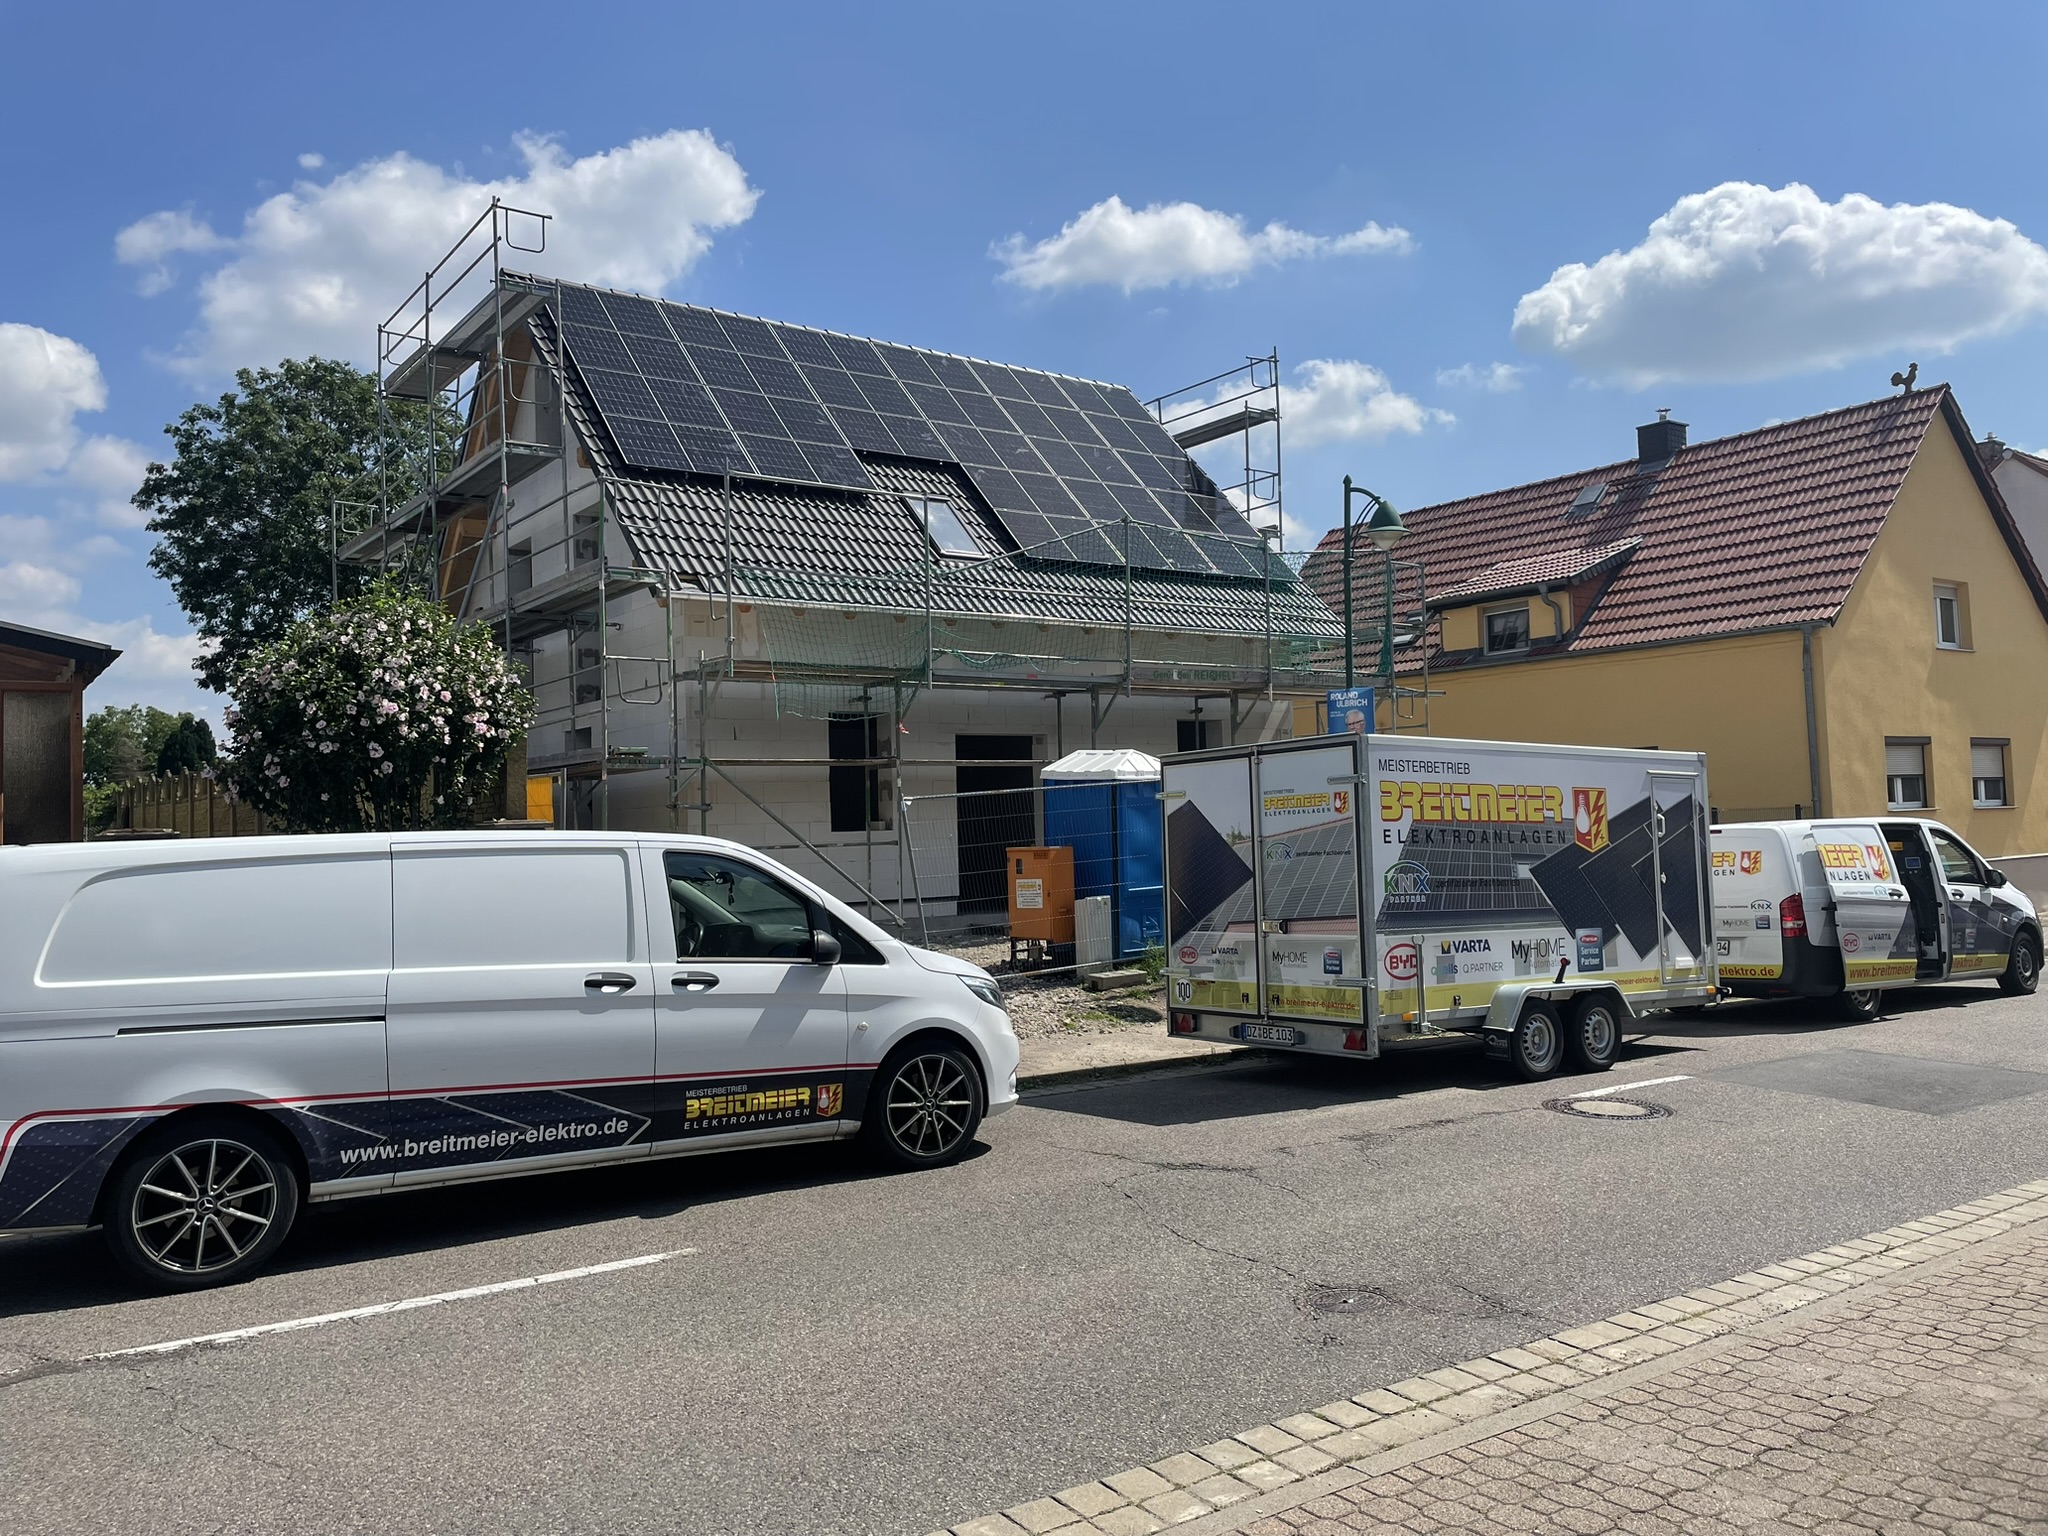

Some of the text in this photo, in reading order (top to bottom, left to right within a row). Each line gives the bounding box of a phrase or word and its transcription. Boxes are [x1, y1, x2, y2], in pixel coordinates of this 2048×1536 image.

[1194, 670, 1237, 680] REICHELT
[1330, 691, 1359, 701] ROLAND
[1336, 698, 1368, 708] ULBRICH
[1378, 758, 1471, 775] MEISTERBETRIEB
[1263, 792, 1331, 811] BREITMEIER
[1380, 780, 1564, 823] BREITMEIER
[1264, 807, 1331, 817] ELEKTROANLAGEN
[1383, 828, 1566, 844] ELEKTROANLAGEN
[1266, 849, 1292, 860] KNX
[1713, 869, 1735, 877] GEN
[1829, 870, 1871, 881] NLAGEN
[1384, 873, 1431, 894] KNX
[1389, 895, 1427, 904] PARTNER
[1874, 933, 1892, 941] VARTA
[1217, 947, 1239, 955] VARTA
[1452, 939, 1491, 954] VARTA
[1511, 937, 1567, 964] MyHOME
[1580, 946, 1600, 956] Service
[1181, 951, 1196, 959] BYD
[1272, 951, 1308, 965] MyHOME
[1389, 954, 1418, 970] BYD
[1580, 956, 1601, 967] Partner
[1849, 963, 1915, 979] www.breitmeier-
[1176, 981, 1191, 999] 100
[1246, 1025, 1293, 1041] DZ BE 103
[685, 1084, 748, 1098] MEISTERBETRIEB
[685, 1086, 812, 1120] BREITMEIER
[684, 1108, 811, 1130] ELEKTROANLAGEN
[339, 1116, 629, 1164] www.breitmeier-elektro.de
